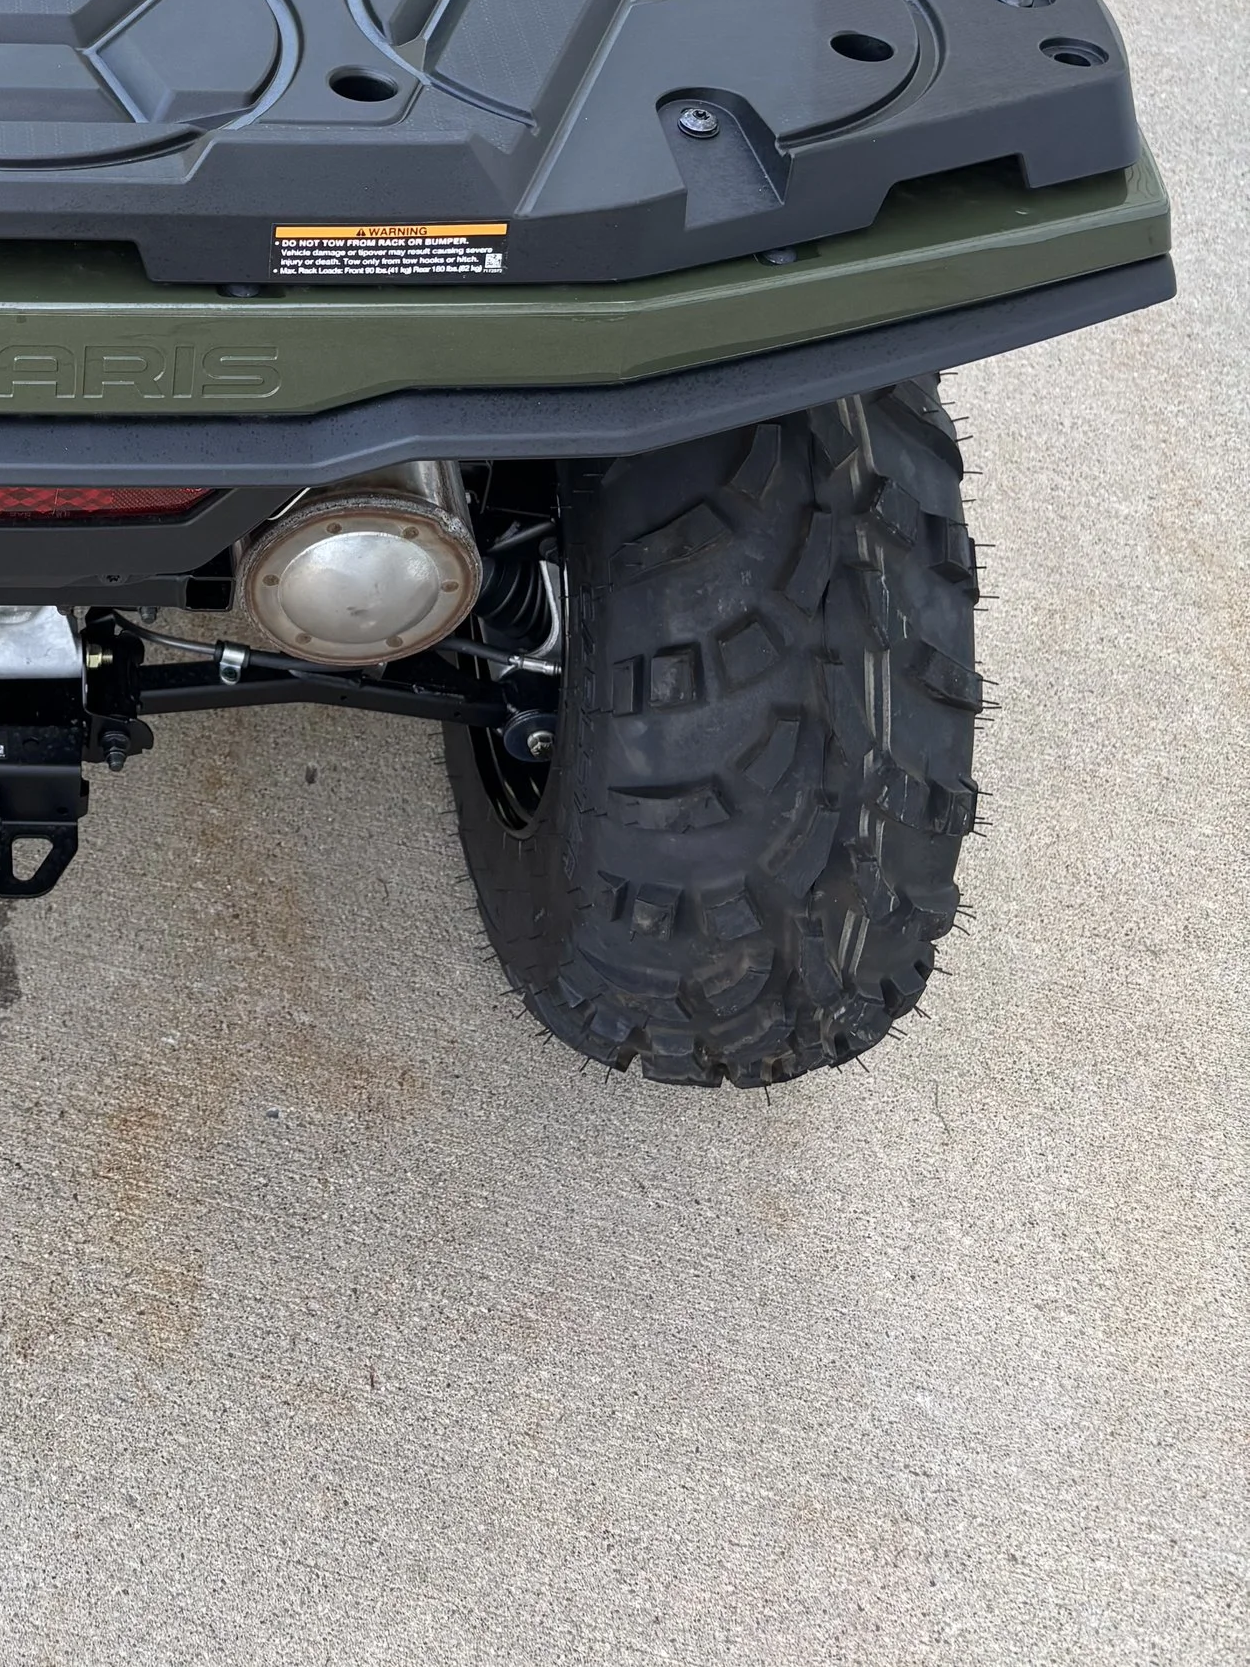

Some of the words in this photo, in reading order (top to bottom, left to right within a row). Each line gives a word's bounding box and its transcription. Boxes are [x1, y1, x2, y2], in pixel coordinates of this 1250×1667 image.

[368, 226, 428, 237] WARNING
[282, 240, 297, 248] DO
[298, 239, 320, 248] NOT
[322, 239, 345, 247] TOW
[346, 239, 376, 247] FROM
[377, 238, 405, 247] RACK
[407, 238, 422, 246] OR
[424, 238, 469, 246] BUMPER.
[281, 249, 310, 257] Vehicle
[312, 249, 345, 259] damage
[357, 248, 386, 258] tipover
[387, 249, 405, 258] may
[407, 247, 430, 256] result
[431, 247, 464, 257] causing
[281, 258, 303, 267] injury
[315, 257, 341, 265] death.
[343, 257, 360, 265] Tow
[362, 257, 379, 266] only
[381, 257, 400, 265] from
[402, 256, 417, 265] tow
[419, 256, 444, 264] hooks
[456, 256, 479, 264] hitch.
